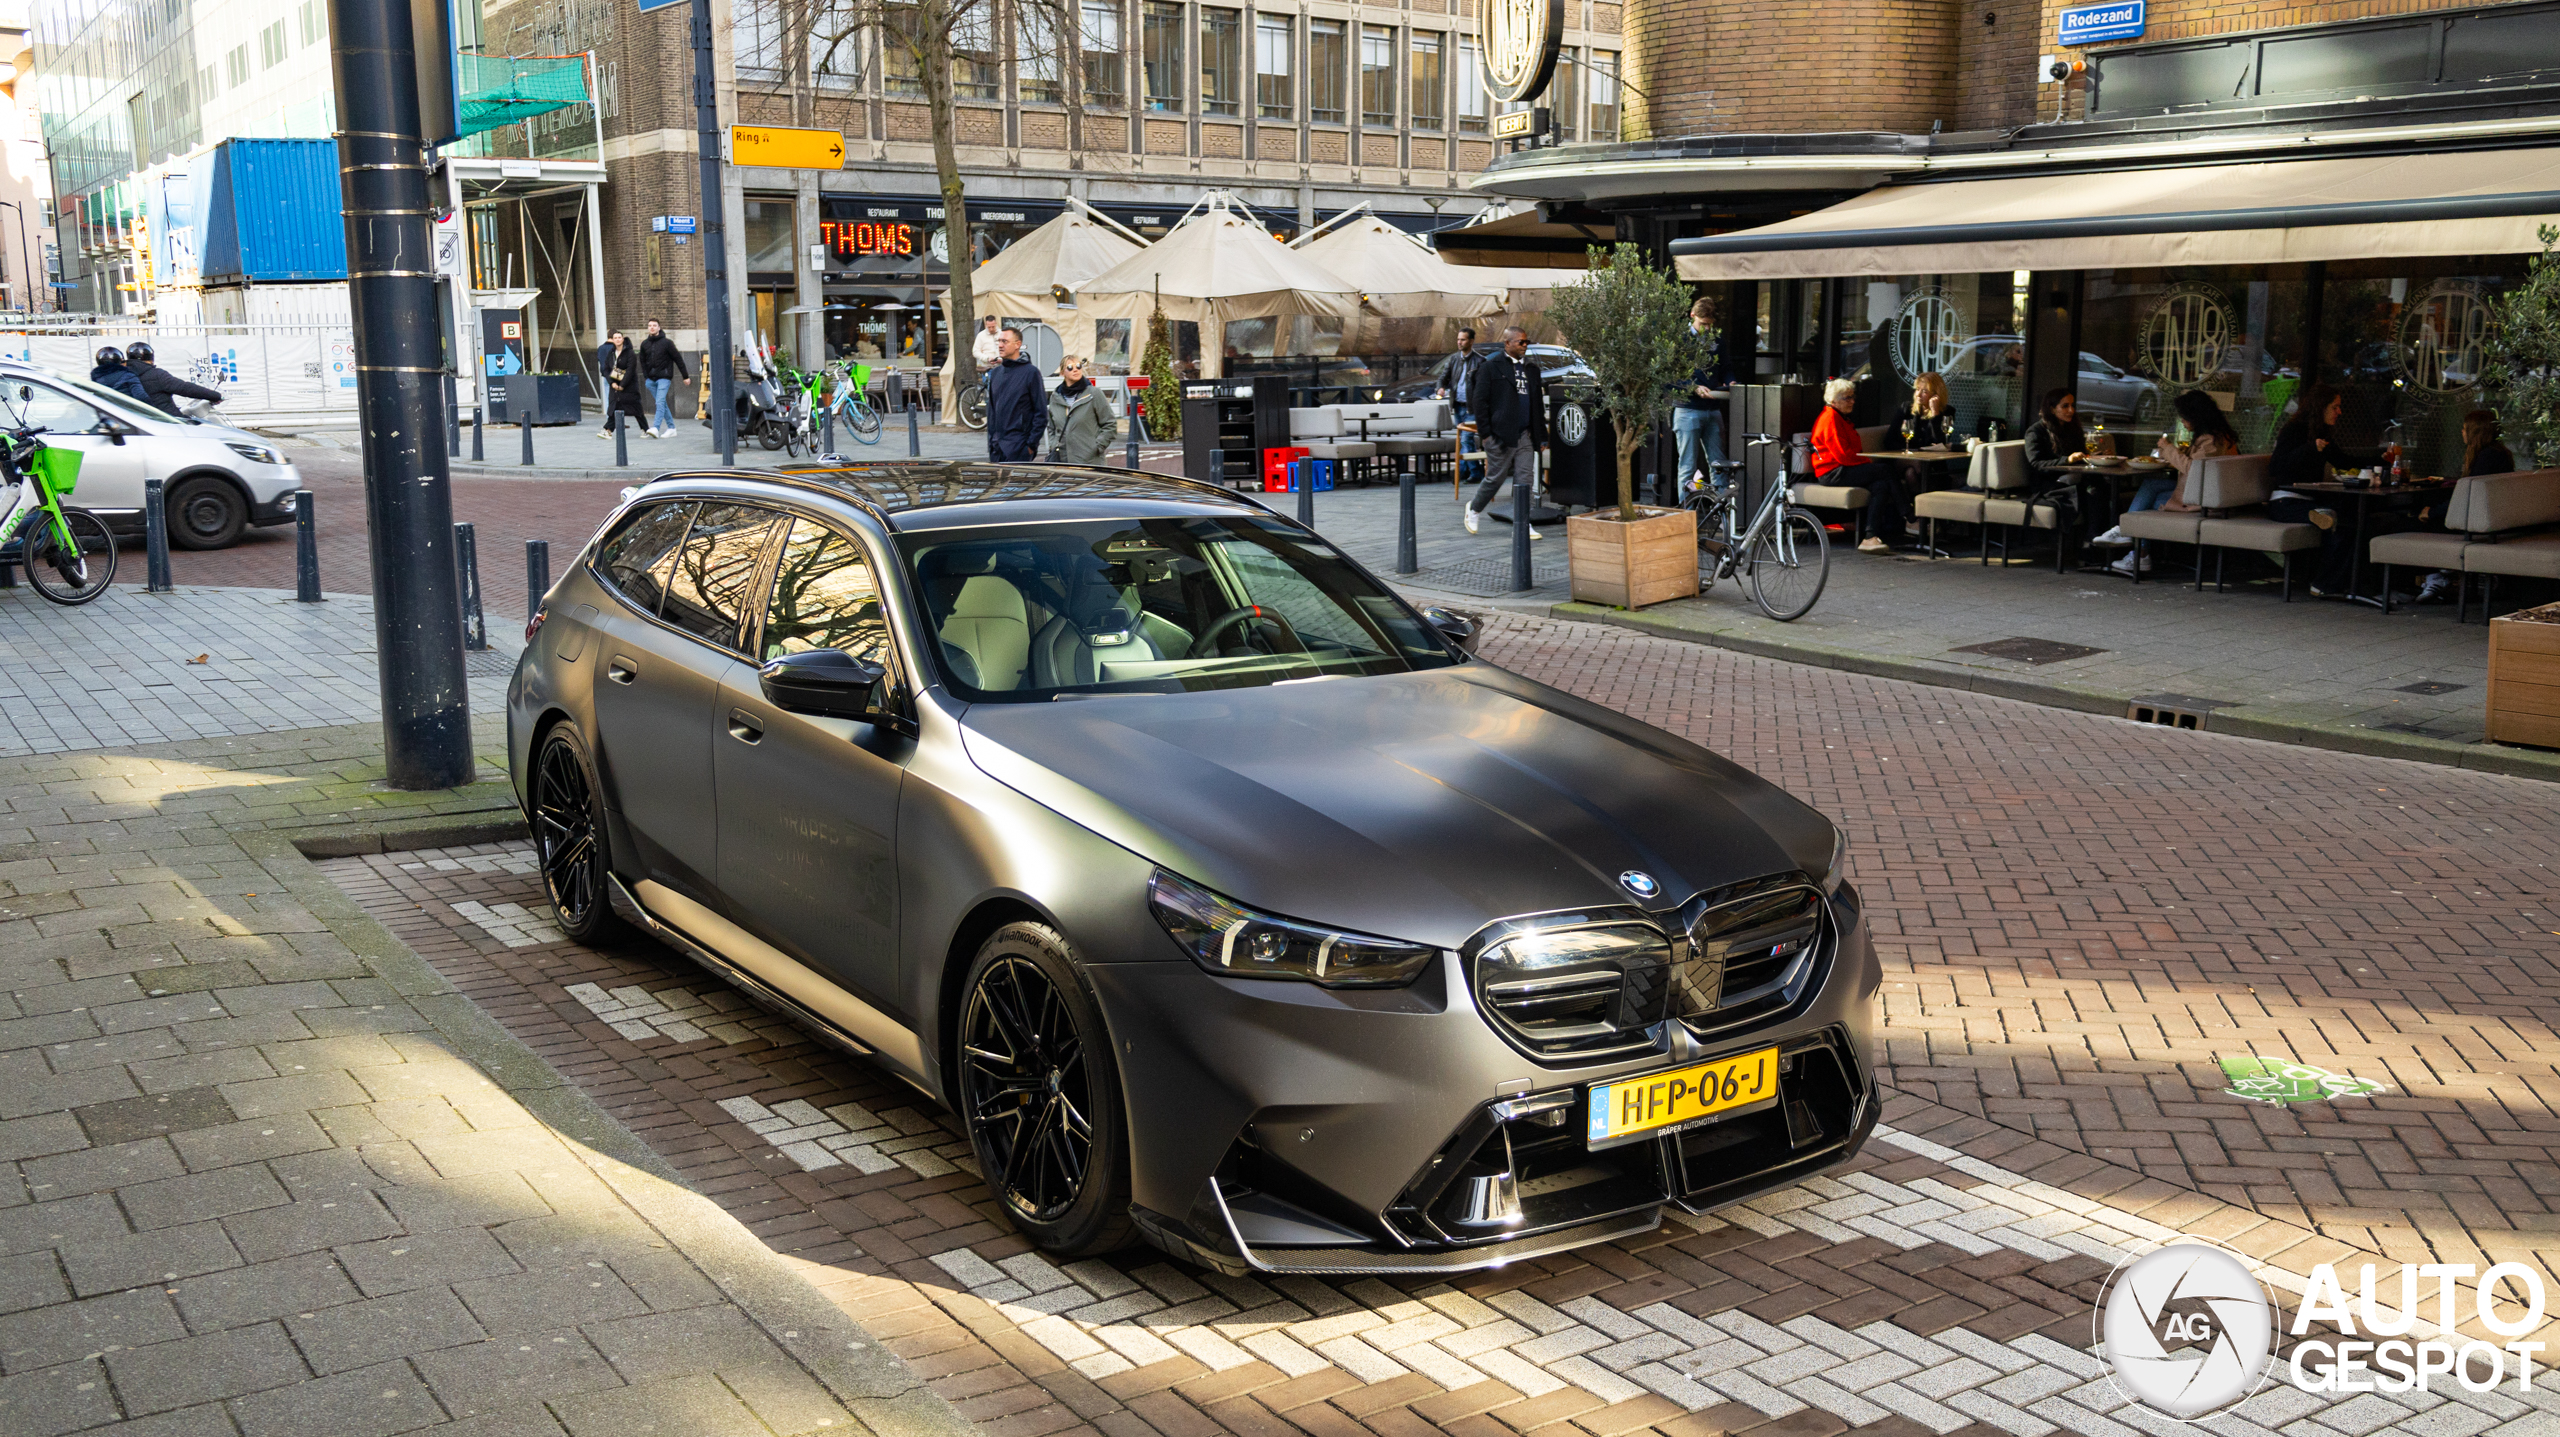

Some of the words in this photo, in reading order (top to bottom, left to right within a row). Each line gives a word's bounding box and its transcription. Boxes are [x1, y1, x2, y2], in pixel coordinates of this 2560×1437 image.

[2068, 7, 2133, 28] Rodezand
[736, 131, 759, 144] Ring
[867, 208, 899, 218] RESTAURANT
[926, 207, 945, 219] THO
[981, 211, 1014, 221] UNDERGROUND
[1015, 213, 1025, 221] BAR
[820, 221, 912, 255] THOMS
[508, 325, 516, 336] B
[858, 322, 887, 334] THOMS
[0, 508, 25, 543] Lime
[1622, 1058, 1764, 1126] HFP-06-J
[1592, 1117, 1606, 1131] NL
[1682, 1115, 1719, 1131] AUTOMOTIVE
